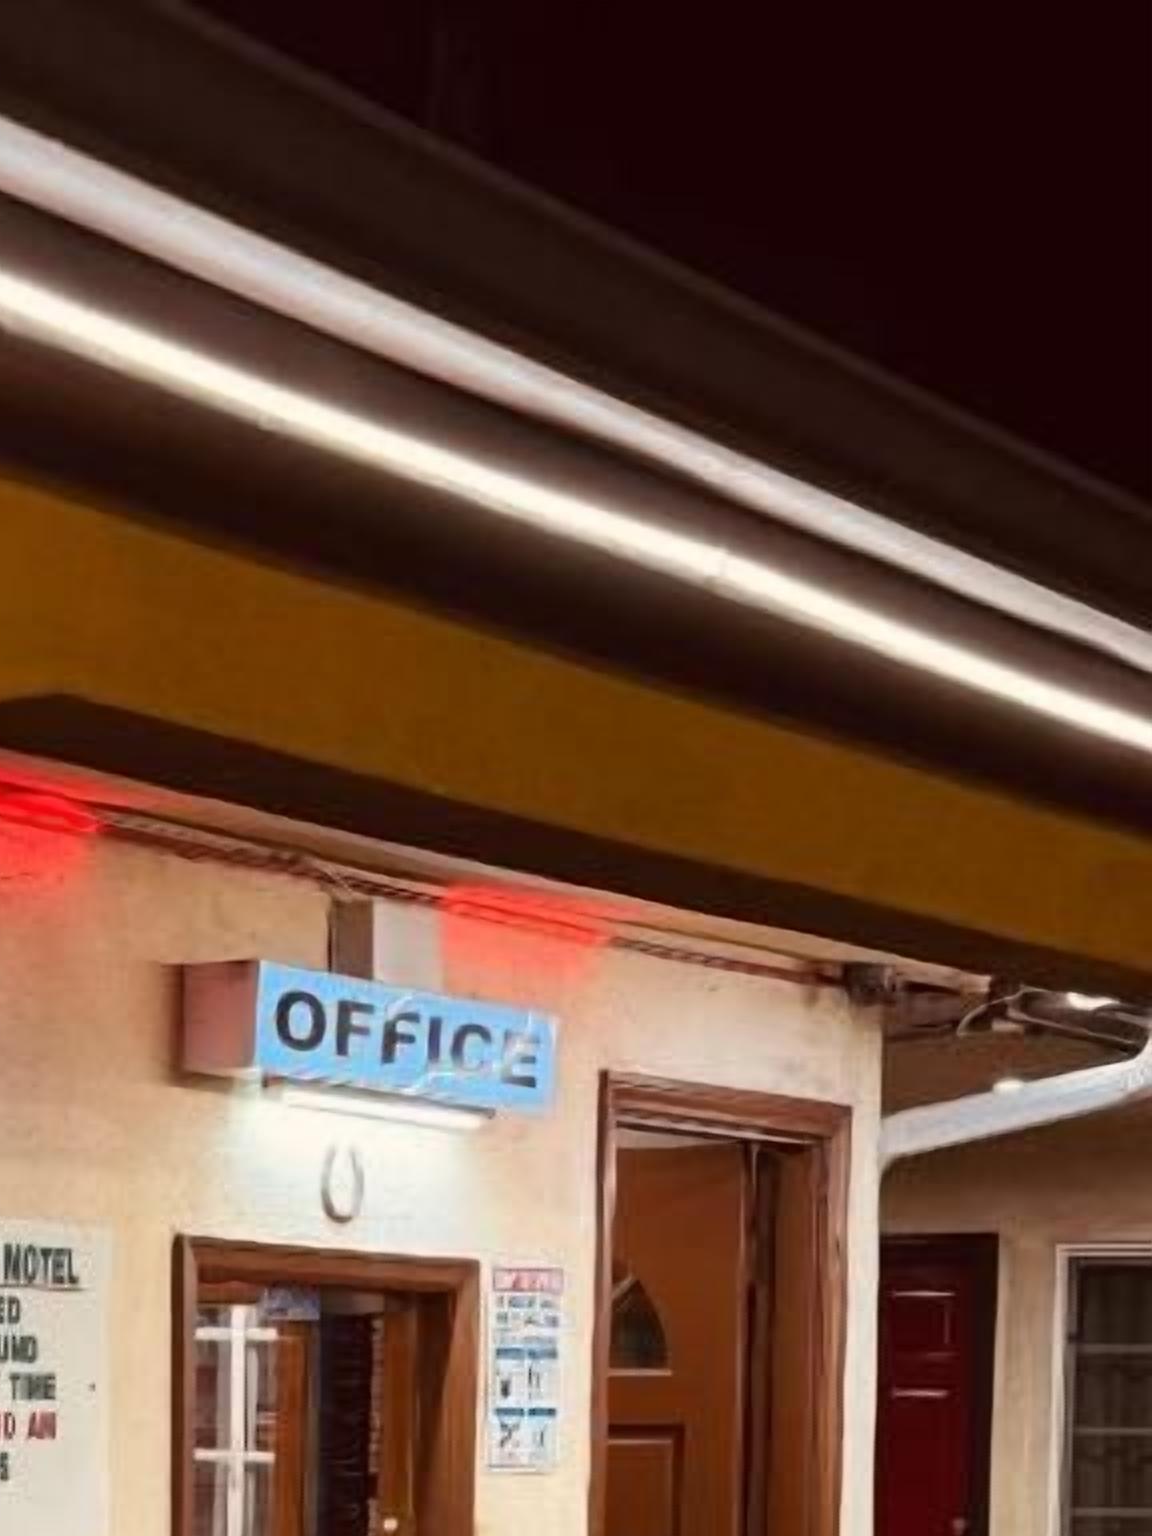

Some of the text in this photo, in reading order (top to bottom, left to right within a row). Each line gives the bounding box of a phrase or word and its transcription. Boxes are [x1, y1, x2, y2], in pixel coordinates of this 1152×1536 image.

[275, 990, 540, 1088] OFFICE
[4, 1242, 79, 1284] MOTEL
[9, 1372, 56, 1400] TIME
[27, 1412, 56, 1440] AM
